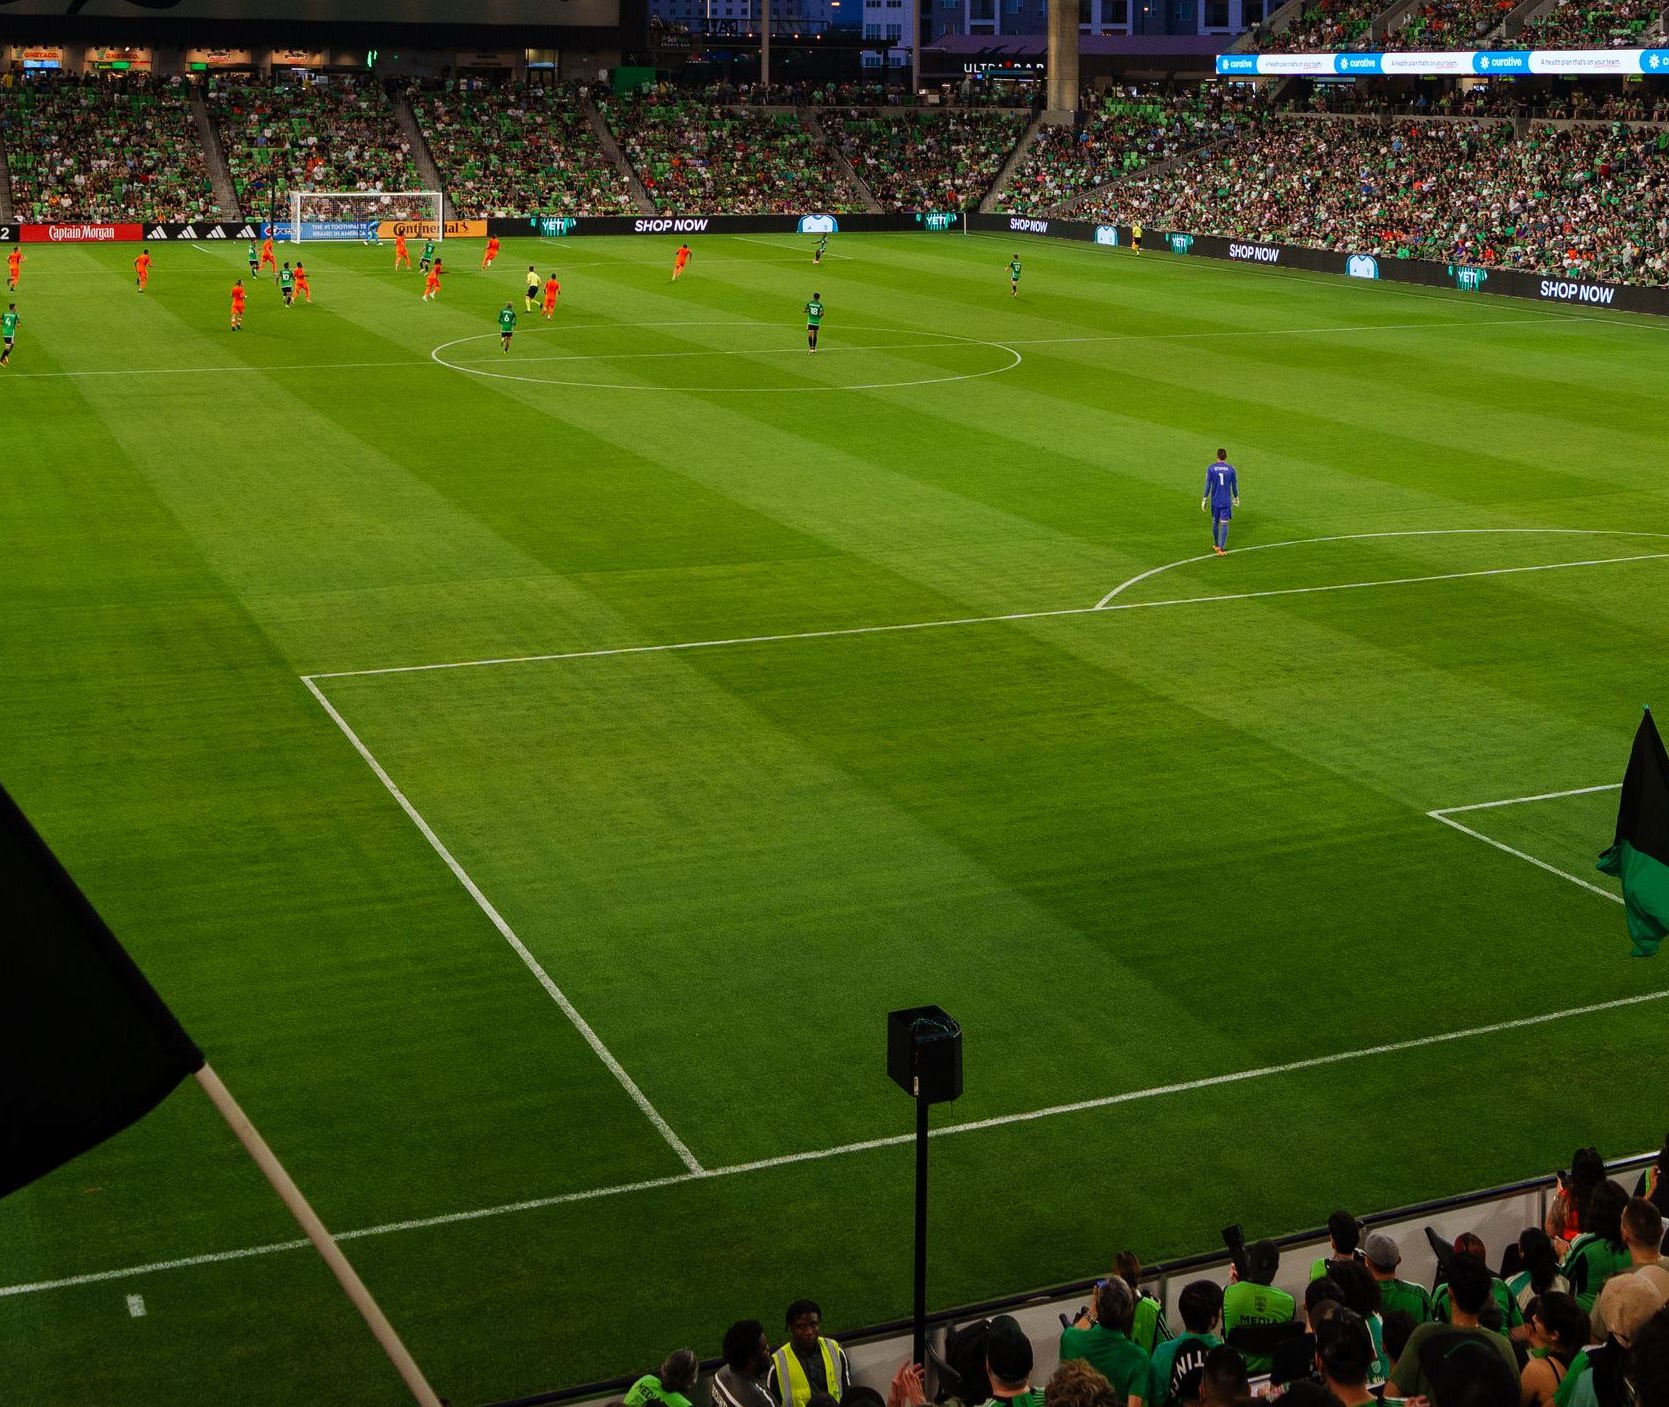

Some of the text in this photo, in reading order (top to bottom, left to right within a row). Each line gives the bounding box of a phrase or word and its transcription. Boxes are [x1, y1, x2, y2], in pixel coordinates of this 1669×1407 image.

[1230, 59, 1253, 68] curative
[1349, 58, 1376, 68] curative
[1491, 56, 1523, 67] curative
[634, 219, 708, 232] SHOP NOW
[926, 215, 946, 225] YETI
[542, 221, 564, 231] YETI
[1009, 218, 1048, 234] SHOP NOW
[48, 225, 114, 242] Captain Morgan
[1173, 237, 1186, 248] YETI
[1229, 243, 1280, 263] SHOP NOW
[1458, 272, 1477, 284] YETI
[1540, 280, 1615, 304] SHOP NOW
[5, 317, 11, 326] 4
[504, 314, 509, 322] 6
[1239, 1314, 1278, 1325] MEDIA
